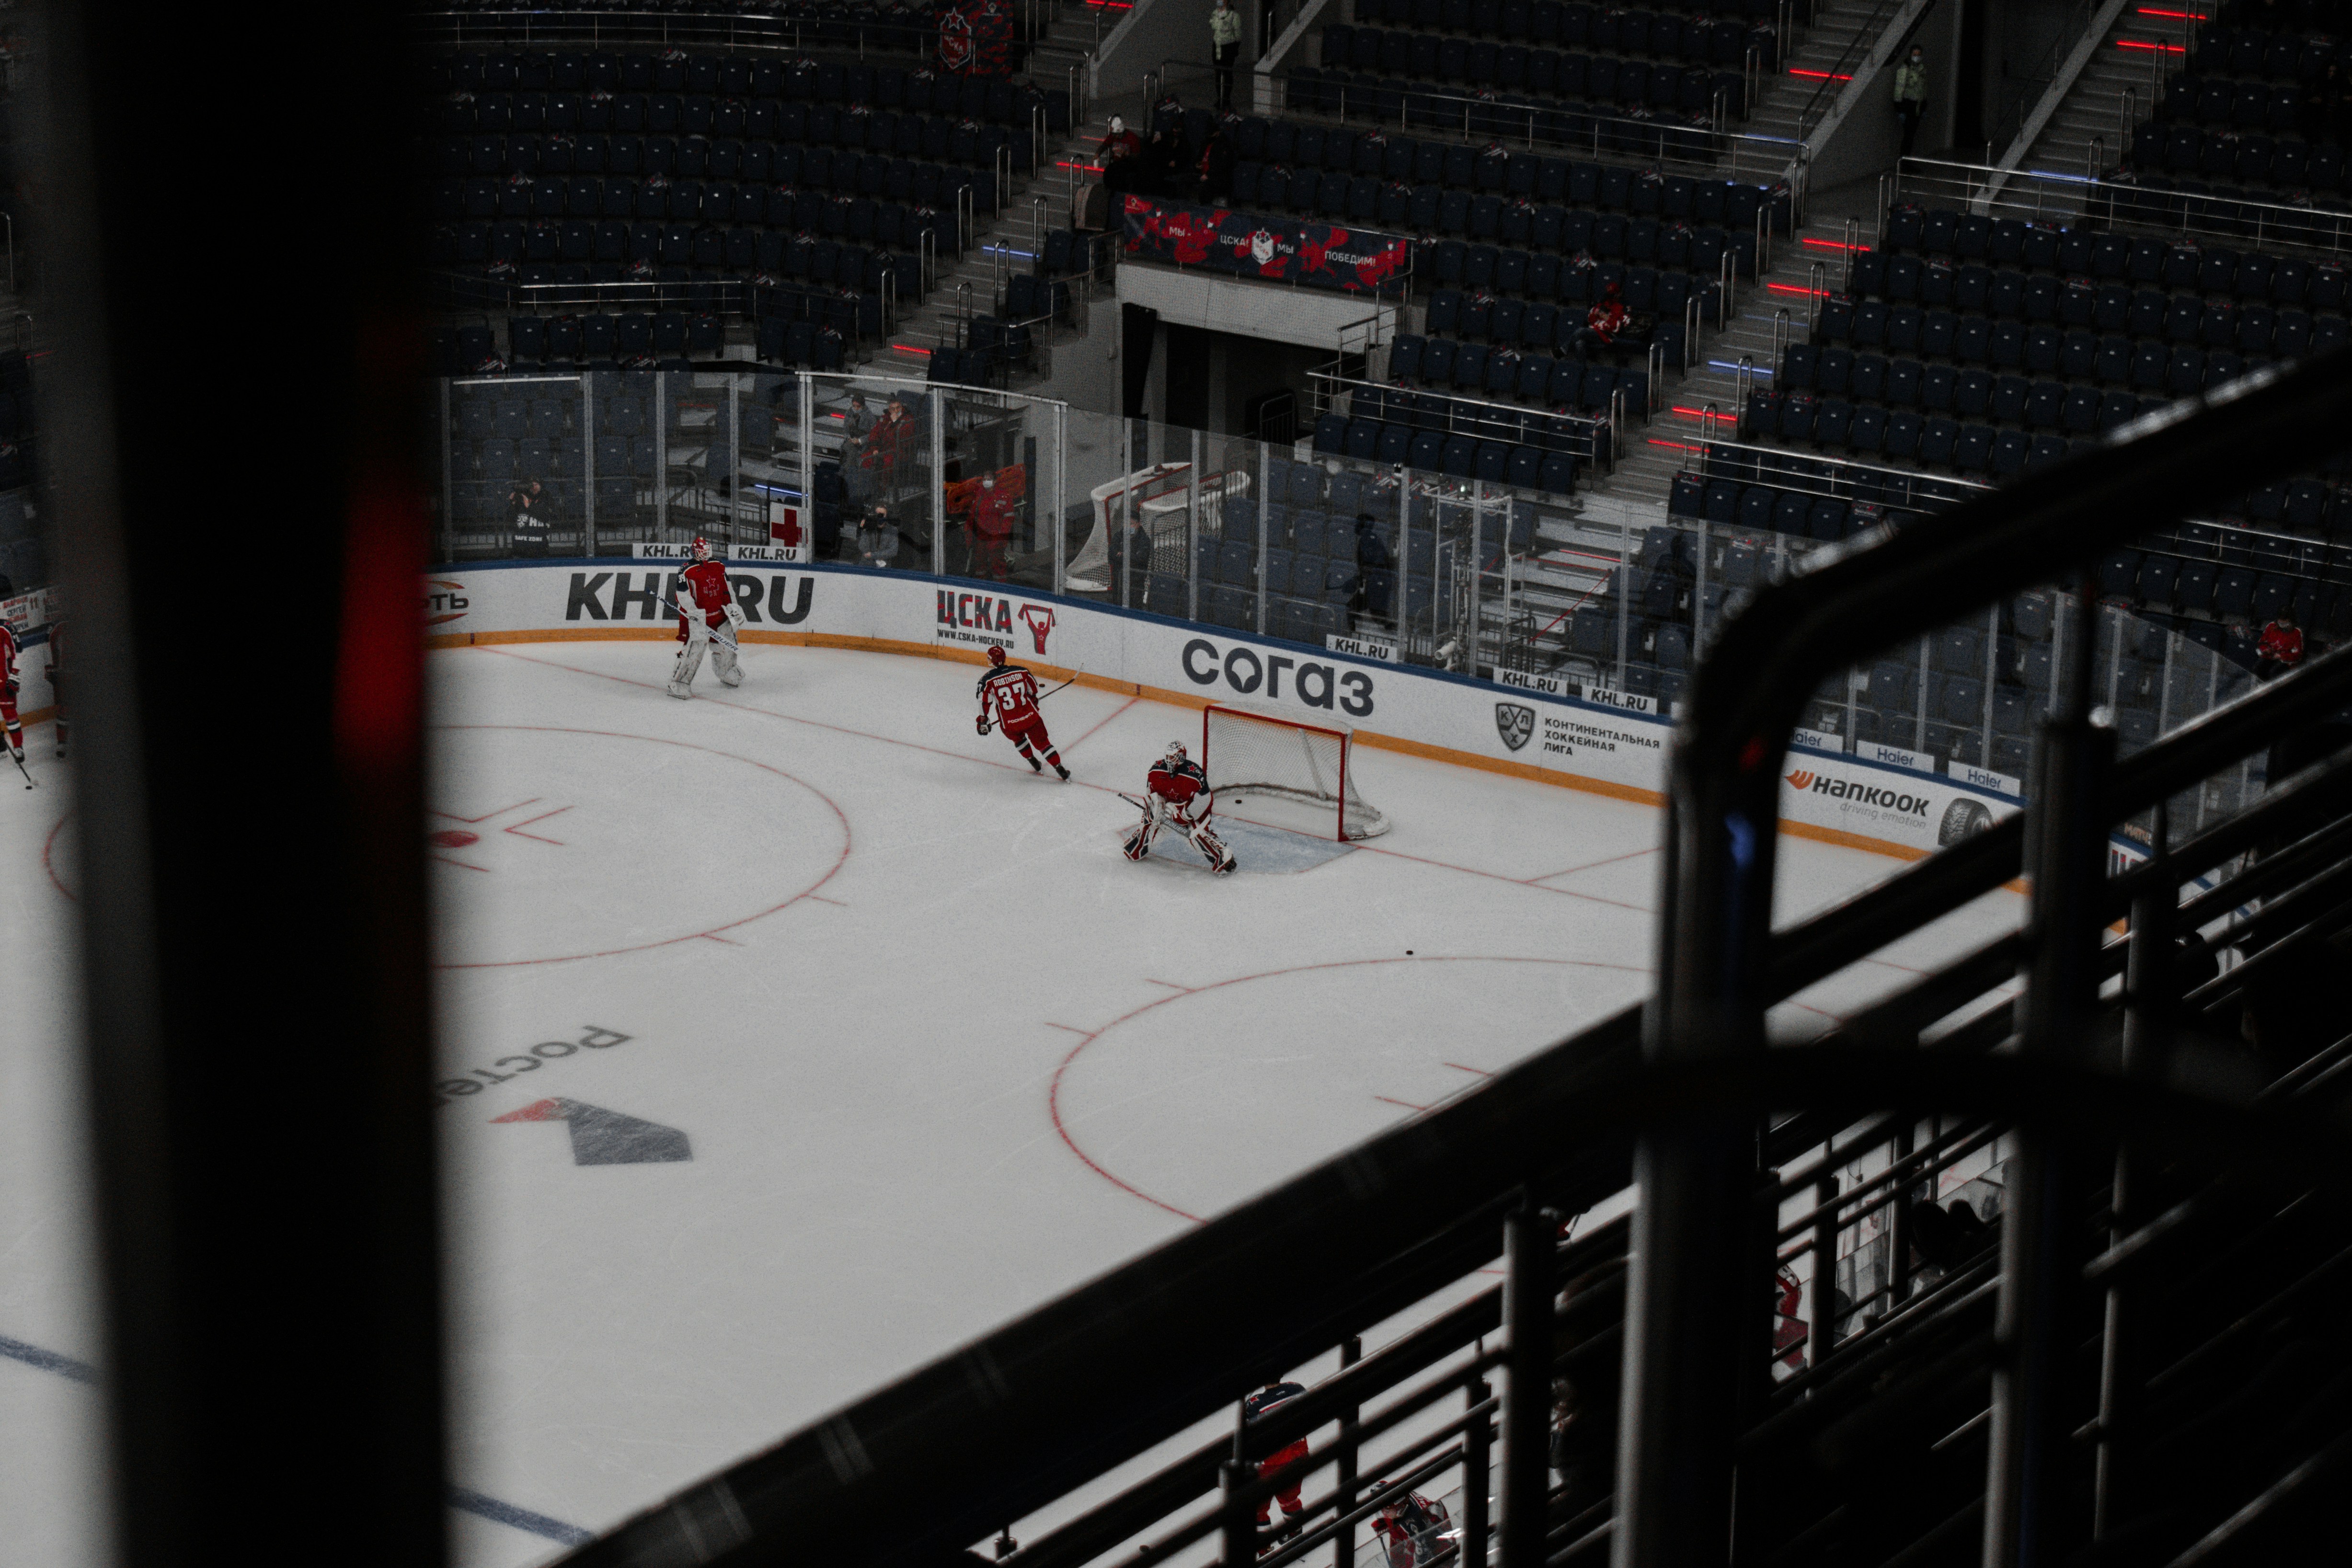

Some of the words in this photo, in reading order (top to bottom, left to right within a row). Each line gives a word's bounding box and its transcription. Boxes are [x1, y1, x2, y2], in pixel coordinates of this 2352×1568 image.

[1169, 226, 1186, 237] МЫ
[1220, 235, 1249, 247] ЦСКА!
[1277, 243, 1294, 254] МЫ
[1324, 251, 1376, 267] ПОБЕДИМ!
[642, 545, 690, 558] KHL.R
[738, 547, 797, 561] KHL.RU
[566, 572, 814, 624] KHLRU
[937, 590, 1013, 634] ЦСКА
[937, 629, 1014, 649] WWW.CSKA-HOCKEY.RU
[1335, 638, 1388, 660] KHL.RU
[993, 673, 1023, 687] ROBINSON
[1502, 671, 1558, 693] KHL.RU
[998, 681, 1026, 710] 37
[1590, 688, 1648, 711] KHL.RU
[1544, 730, 1615, 752] ХОККЕЙНАЯ
[1545, 717, 1660, 749] КОНТИНЕНТАЛЬНАЯ
[1791, 730, 1822, 747] aier
[1544, 742, 1573, 755] ЛИГА
[1877, 747, 1914, 767] Haier
[1967, 769, 2002, 788] Haier
[1839, 801, 1878, 820] driving
[1881, 813, 1927, 829] emotion
